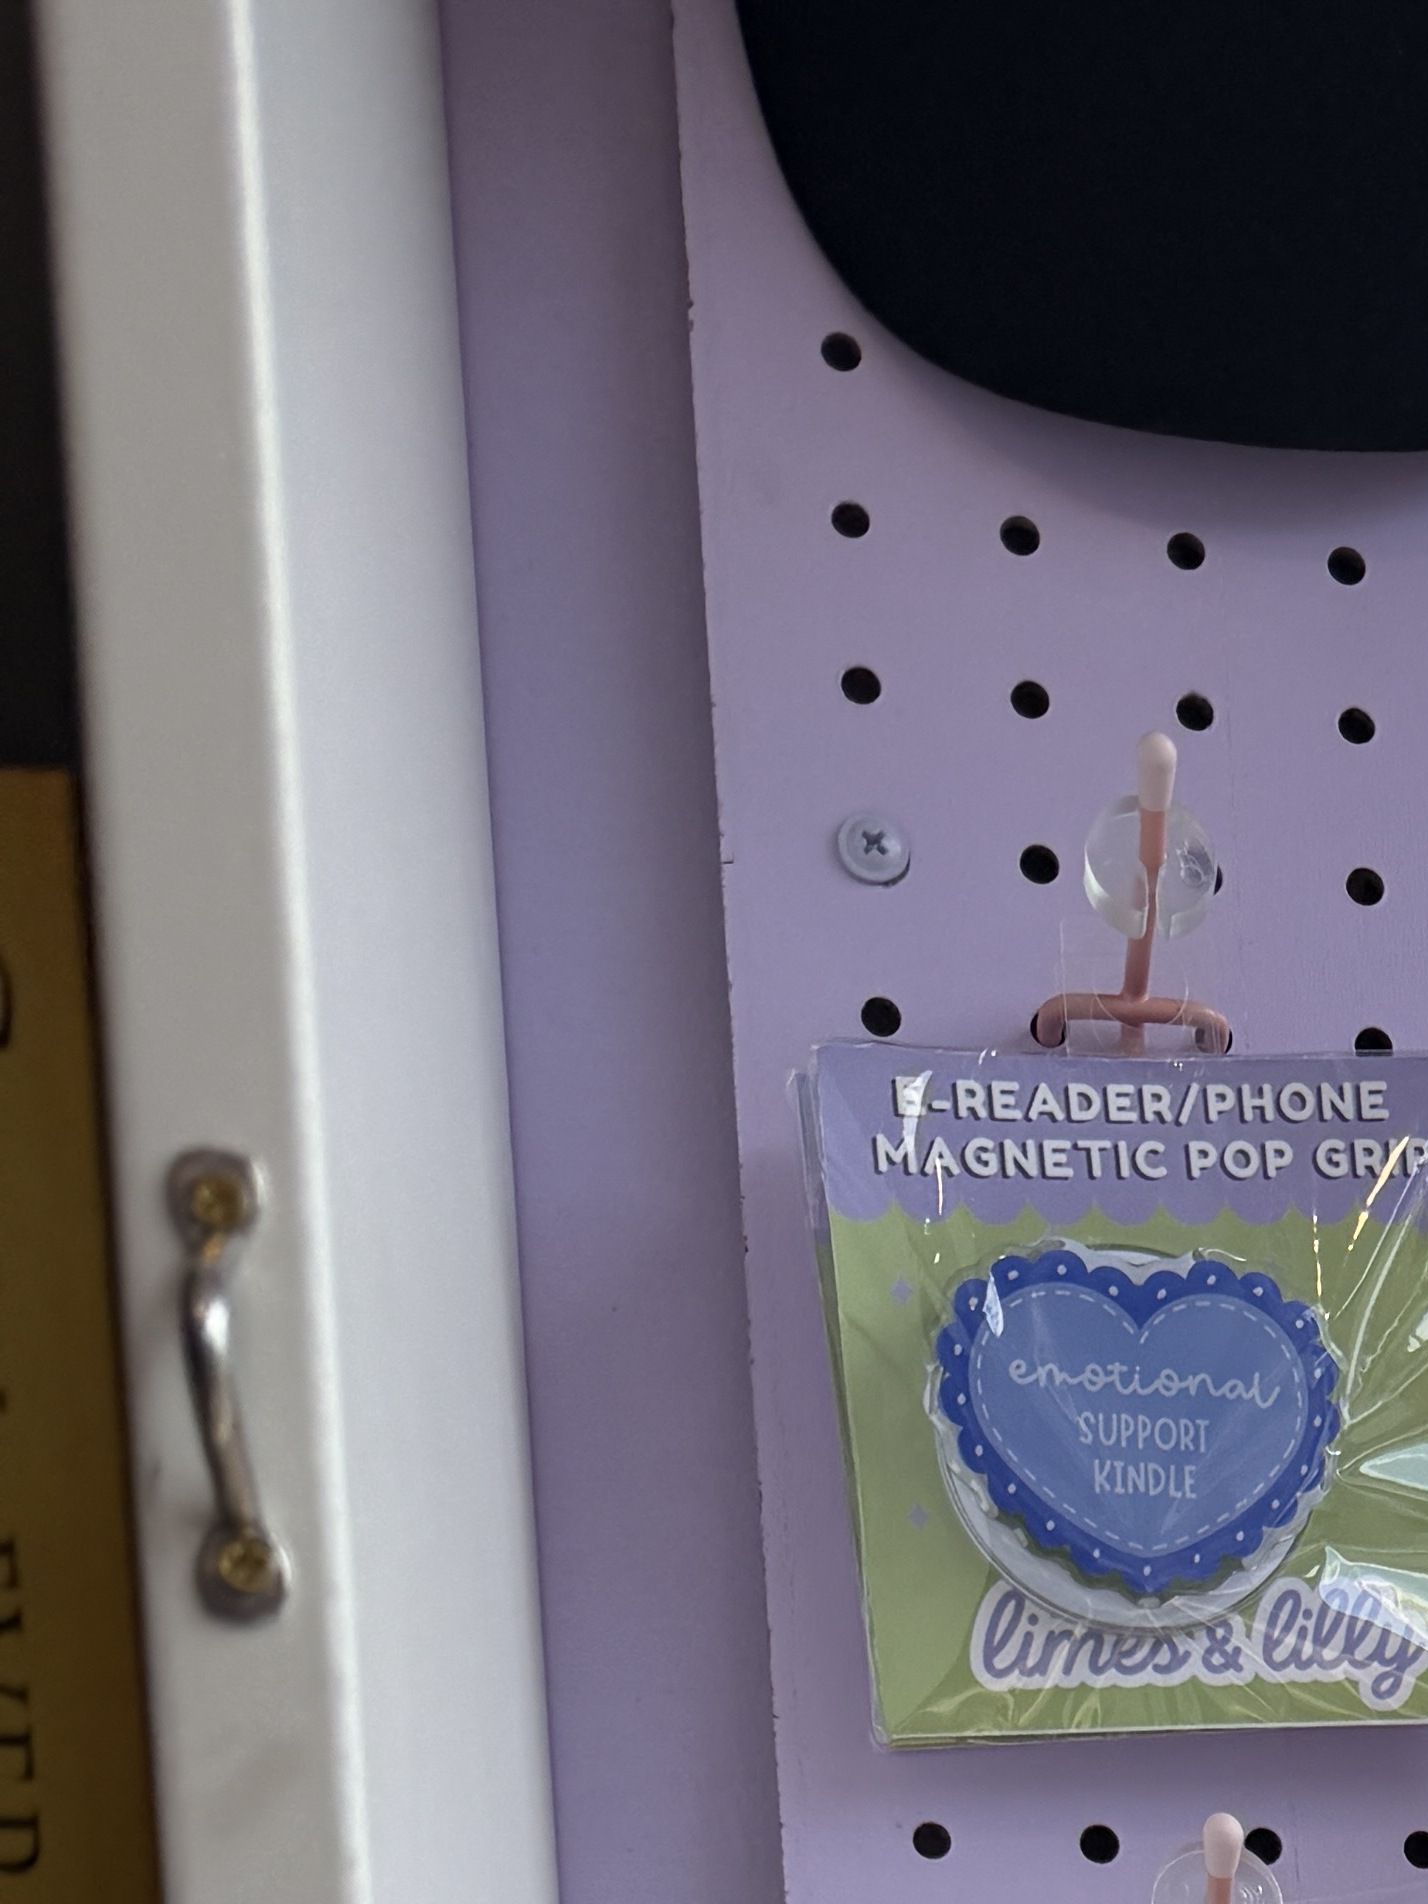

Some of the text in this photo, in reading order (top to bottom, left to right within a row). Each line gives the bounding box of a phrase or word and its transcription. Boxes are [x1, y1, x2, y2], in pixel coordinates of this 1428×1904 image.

[891, 1076, 1391, 1127] E-READER/PHONE
[873, 1134, 1179, 1180] MAGNETIC
[1185, 1136, 1294, 1178] POP
[1008, 1358, 1281, 1409] emotional
[1077, 1412, 1210, 1455] SUPPORT
[1093, 1460, 1200, 1500] KINDLE
[1200, 1620, 1246, 1673] &
[1263, 1587, 1427, 1701] lilly
